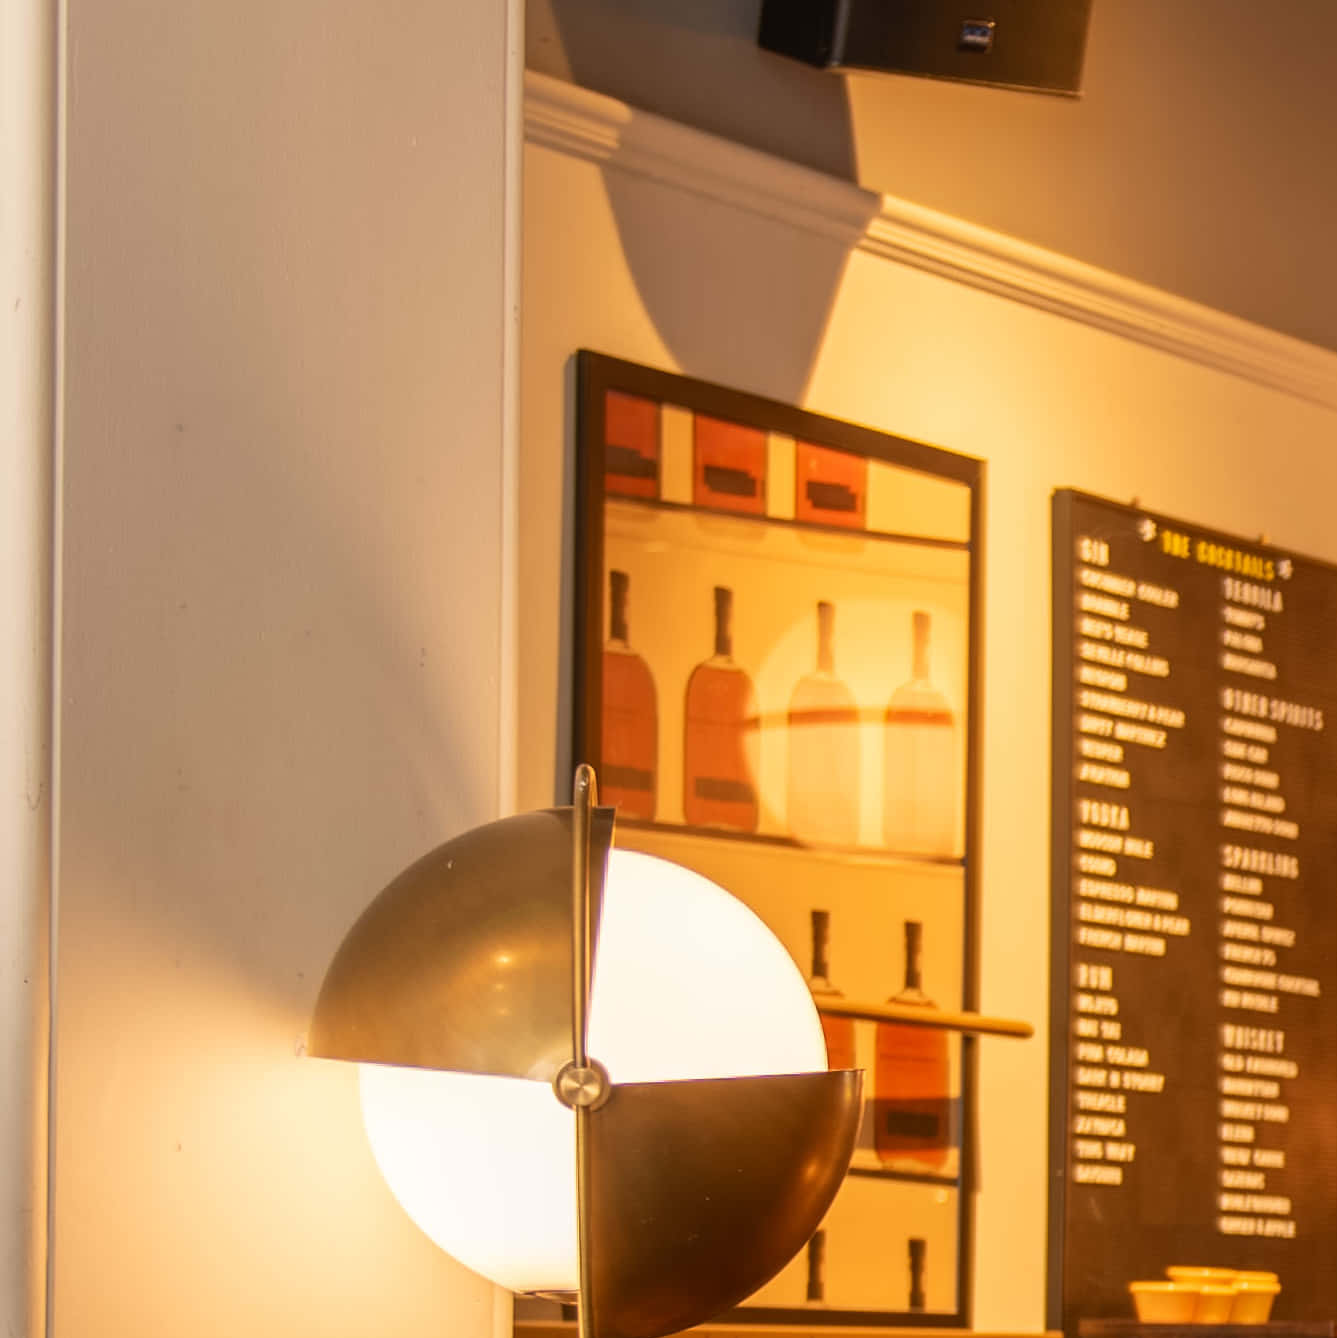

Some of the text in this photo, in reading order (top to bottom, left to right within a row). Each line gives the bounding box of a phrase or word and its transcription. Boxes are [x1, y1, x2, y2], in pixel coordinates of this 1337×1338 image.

[1080, 539, 1109, 566] GIN
[1163, 531, 1275, 581] THE COCKTAILS
[1224, 578, 1283, 612] TEQUILA
[1223, 689, 1269, 717] OTHER
[1270, 700, 1323, 730] SPIRITS
[1080, 800, 1129, 830] VODKA
[1224, 846, 1298, 878] SPARKLING
[1078, 964, 1112, 990] RUM
[1223, 1025, 1284, 1052] WHISKEY
